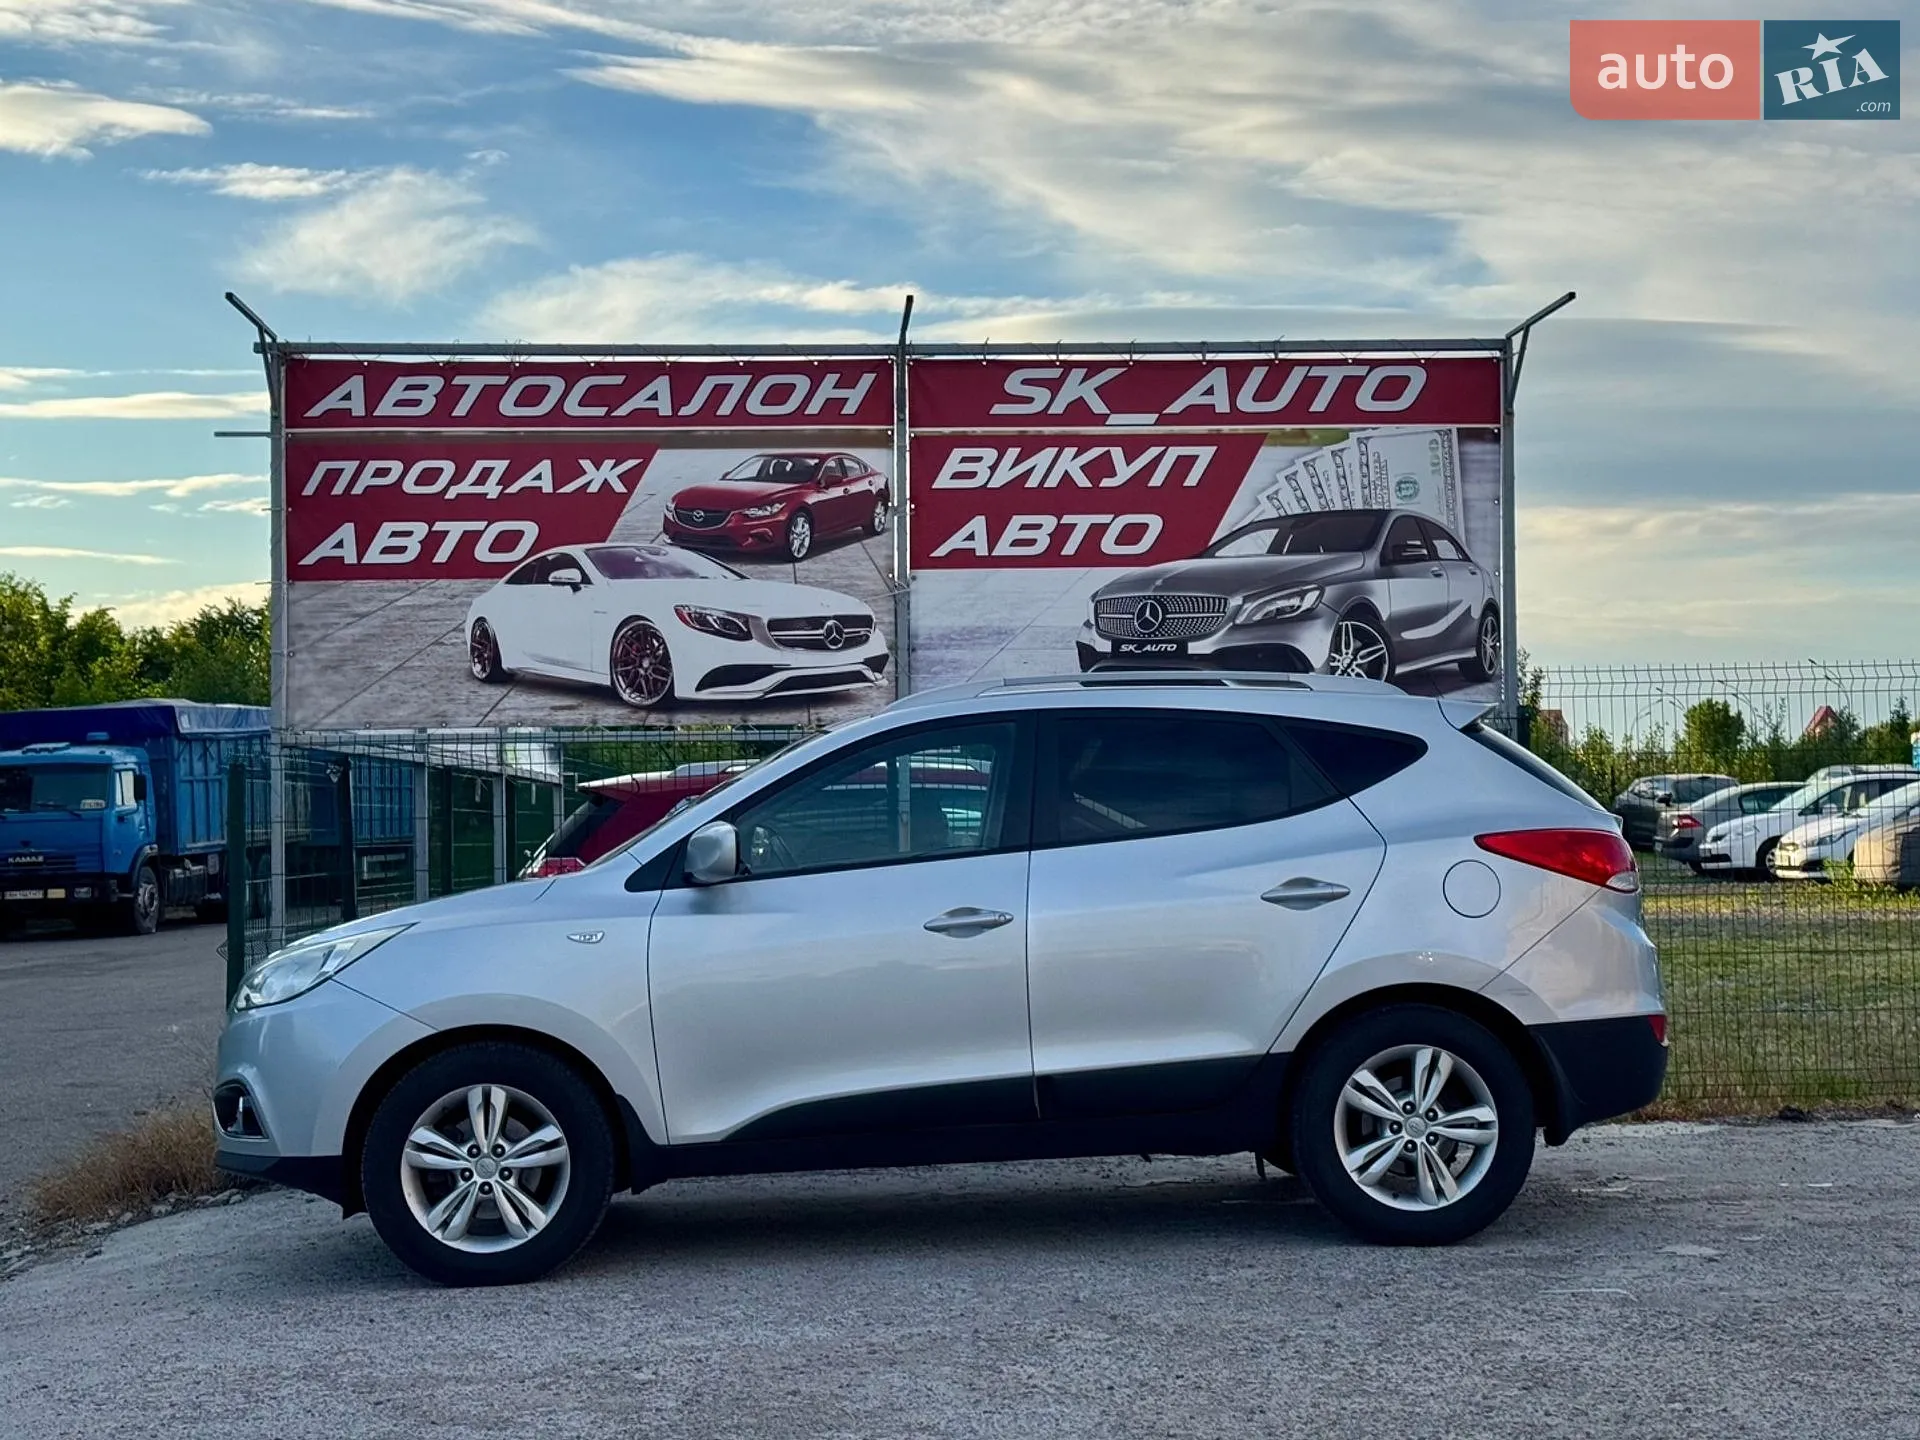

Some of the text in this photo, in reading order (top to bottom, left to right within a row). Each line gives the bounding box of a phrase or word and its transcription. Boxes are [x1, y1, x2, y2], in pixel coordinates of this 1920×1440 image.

[303, 373, 877, 417] АВТОСАЛОН
[989, 365, 1428, 426] SK_AUTO
[302, 458, 645, 501] ПРОДАЖ
[931, 445, 1218, 489] ВИКУП
[298, 520, 540, 566] АВТО
[929, 513, 1164, 557] АВТО
[1119, 643, 1178, 654] SK_AUTO
